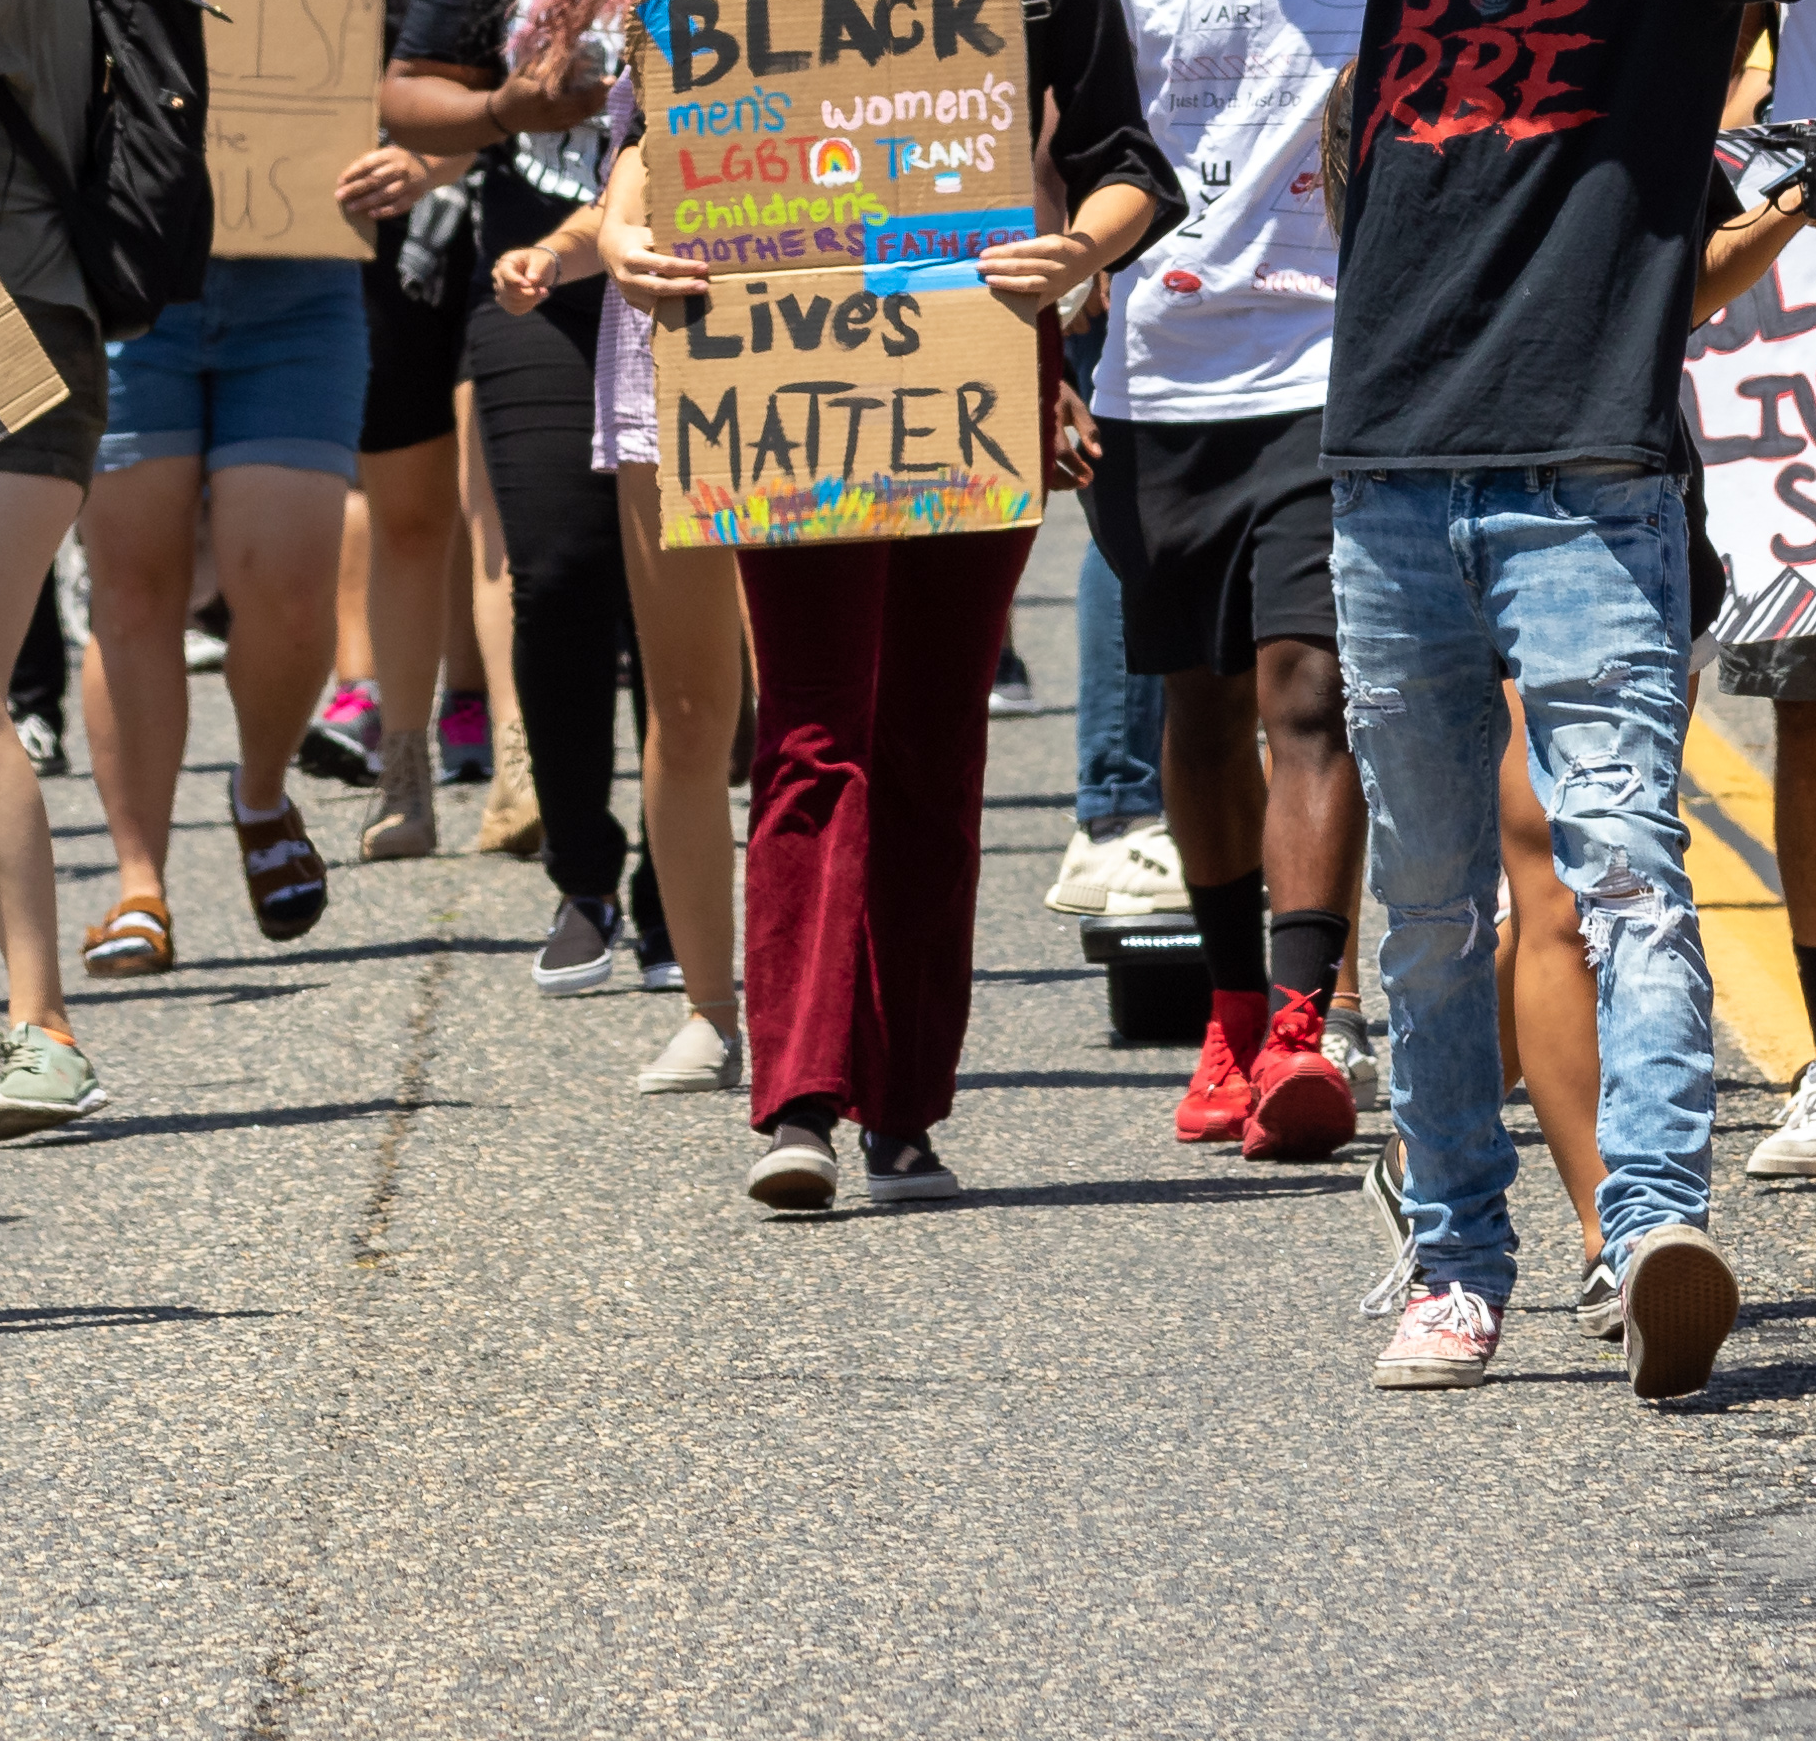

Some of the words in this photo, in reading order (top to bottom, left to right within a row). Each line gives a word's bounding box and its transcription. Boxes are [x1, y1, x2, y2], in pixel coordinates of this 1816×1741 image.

[667, 84, 793, 138] men's
[1169, 92, 1199, 113] Just
[1202, 92, 1224, 109] Do
[1245, 91, 1276, 110] Just
[1278, 90, 1303, 109] Do
[676, 134, 820, 192] LGBT
[676, 379, 1023, 495] MATTER
